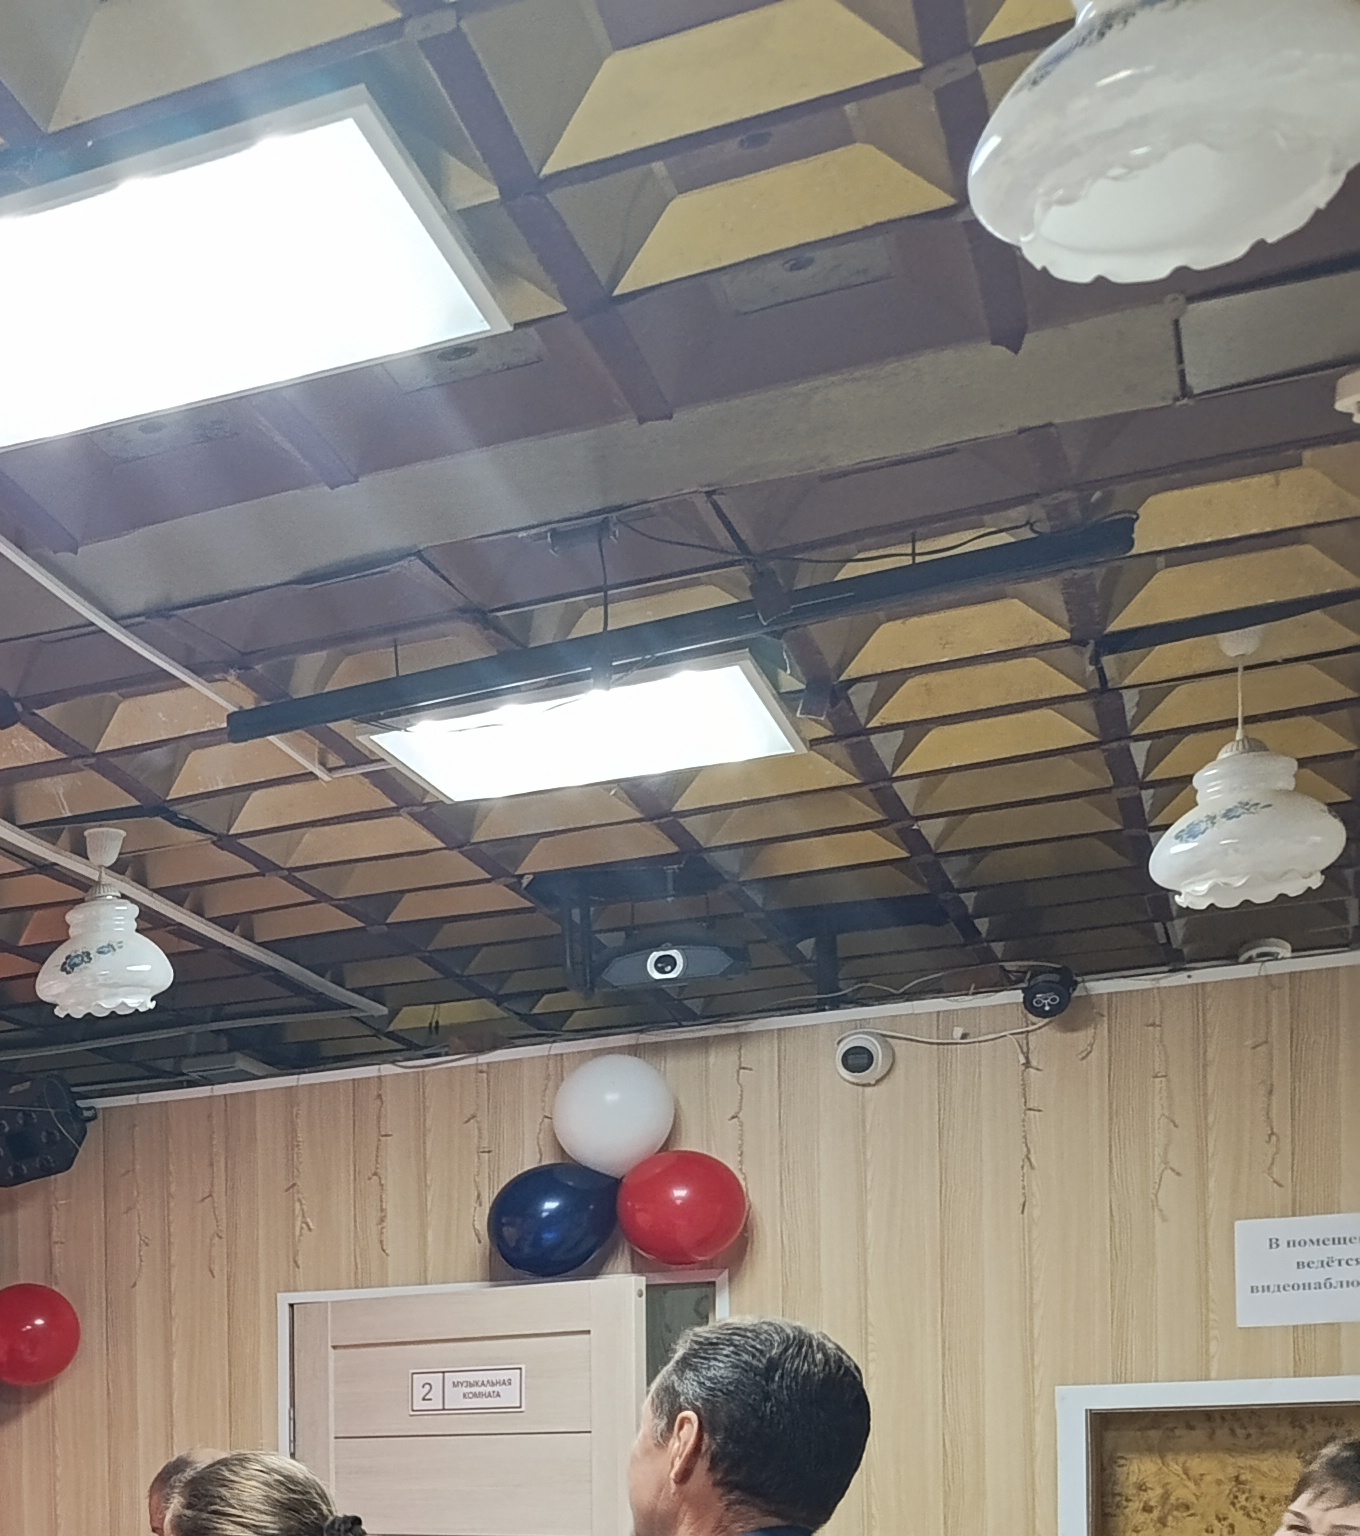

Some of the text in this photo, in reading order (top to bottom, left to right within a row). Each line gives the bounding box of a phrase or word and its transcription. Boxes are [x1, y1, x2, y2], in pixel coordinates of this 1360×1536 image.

[1268, 1235, 1360, 1250] В помеще
[452, 1378, 512, 1389] МУЗЫКАЛЬНАЯ
[421, 1382, 433, 1402] 2
[462, 1391, 502, 1400] КОМНАТА
